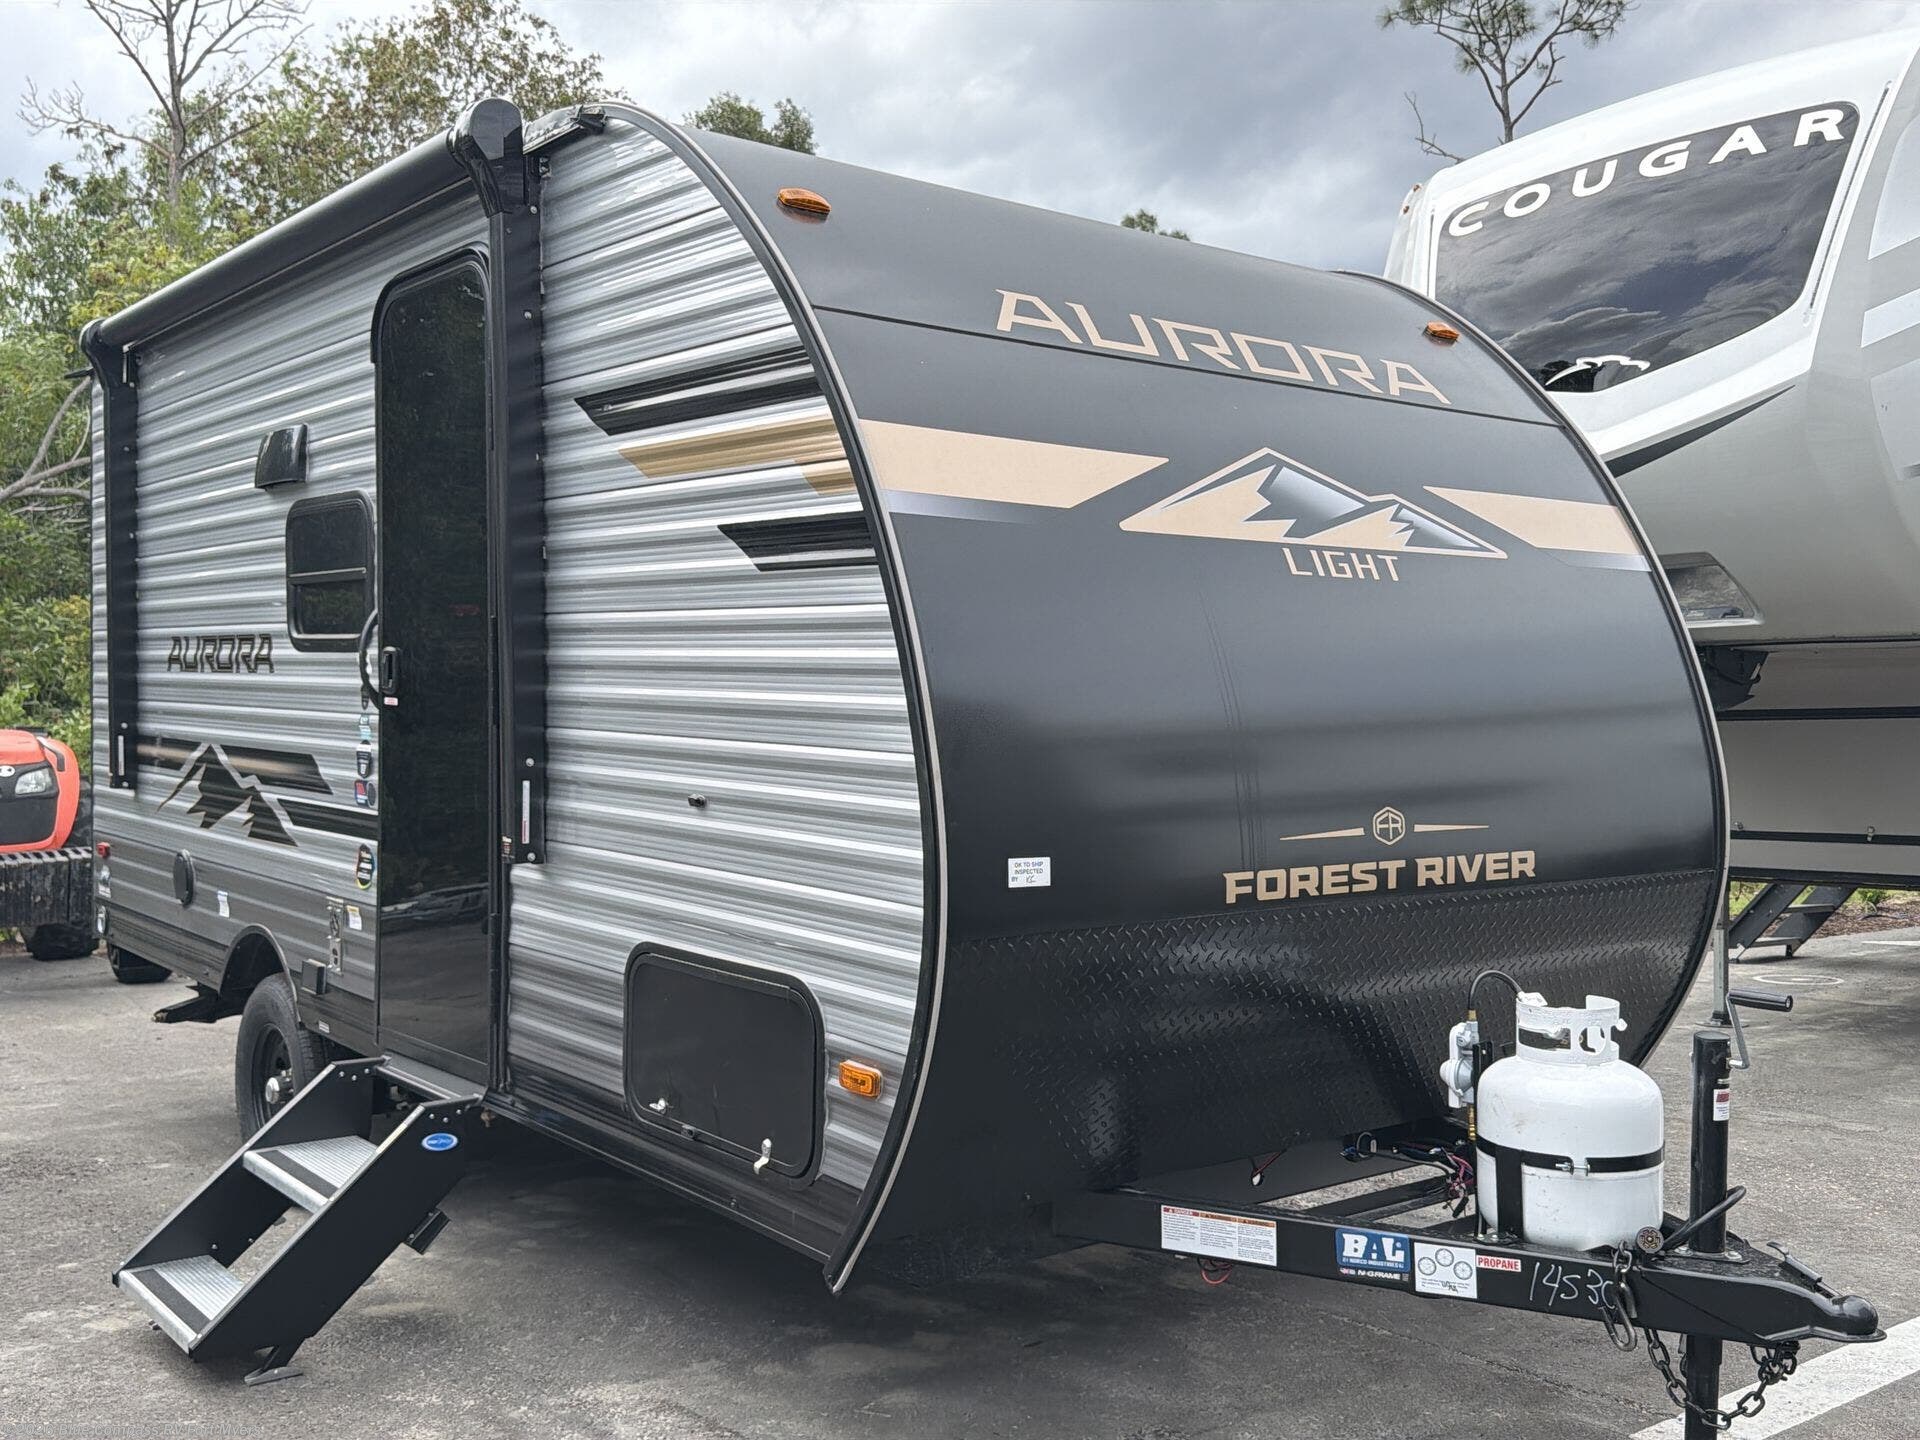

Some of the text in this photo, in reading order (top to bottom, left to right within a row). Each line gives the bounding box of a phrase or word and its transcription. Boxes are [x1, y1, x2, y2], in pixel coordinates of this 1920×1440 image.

[1448, 108, 1845, 238] COUGAR
[995, 288, 1452, 405] AURORA
[1281, 547, 1400, 582] LIGHT
[167, 634, 275, 674] AURORA
[1222, 850, 1537, 905] FOREST RIVER
[1477, 1257, 1520, 1271] PROPANE
